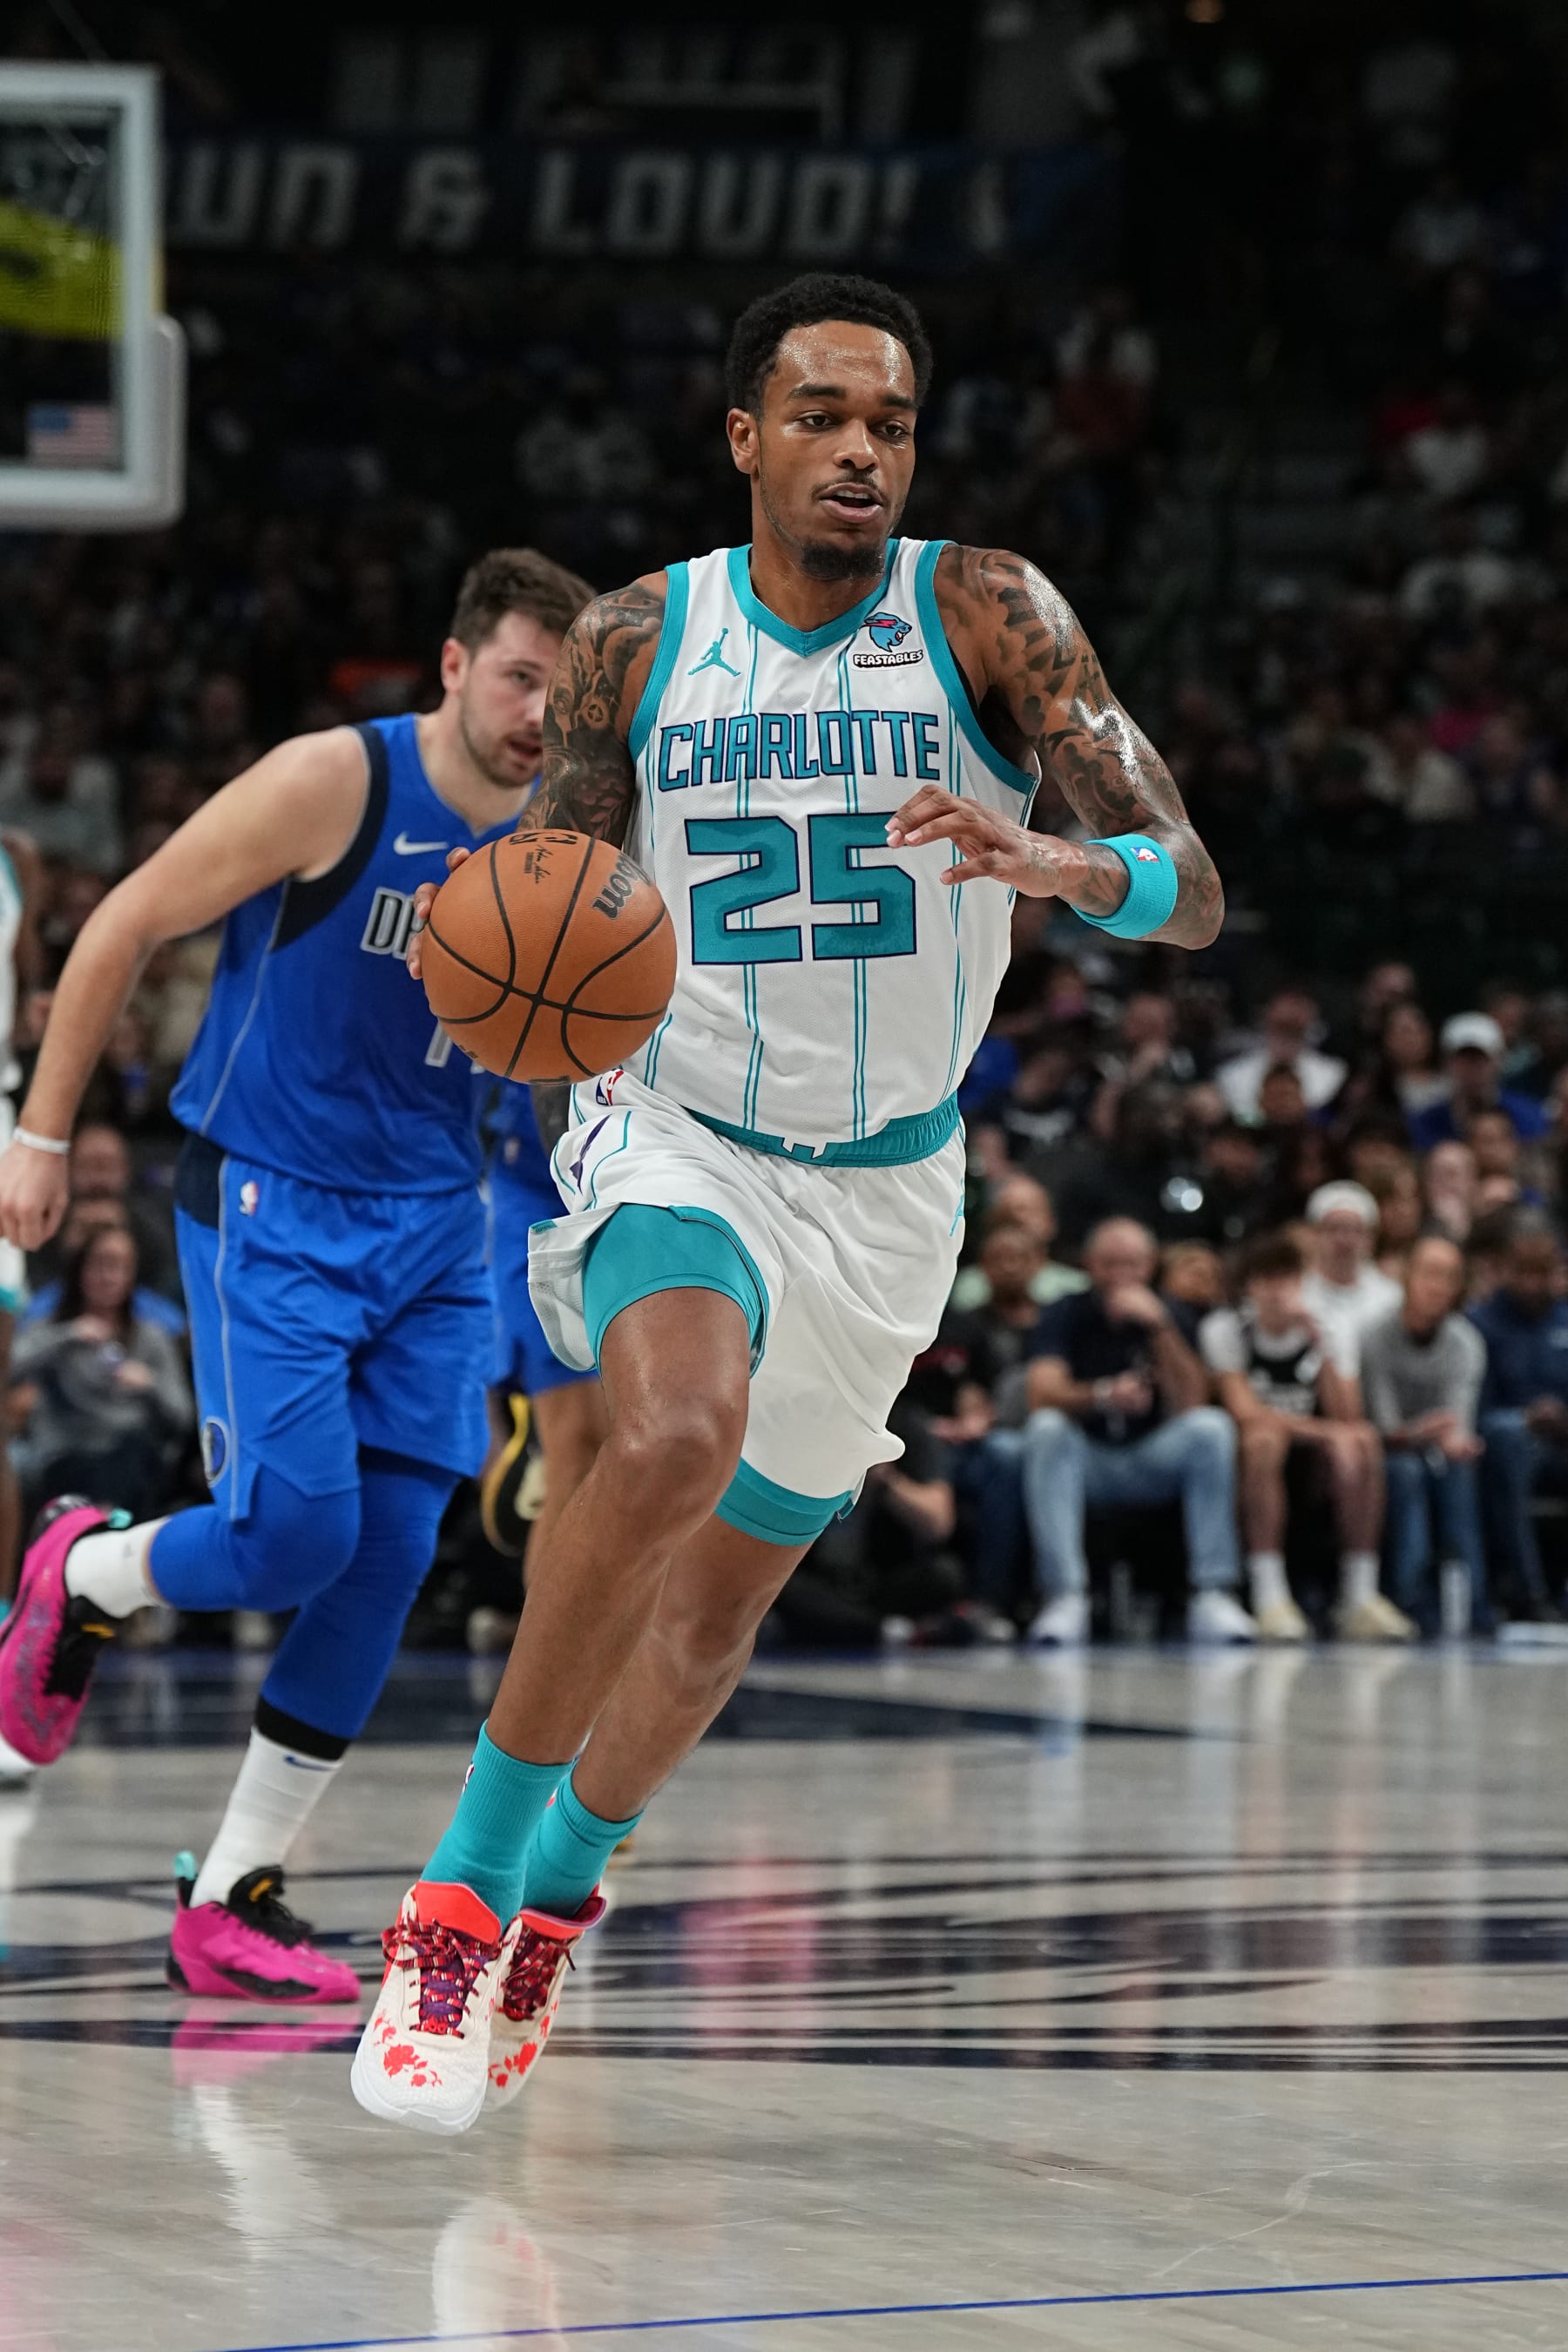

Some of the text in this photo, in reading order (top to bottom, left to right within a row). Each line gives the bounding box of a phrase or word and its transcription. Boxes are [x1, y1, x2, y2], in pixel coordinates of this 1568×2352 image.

[179, 142, 358, 253] UN
[531, 143, 919, 256] LOUD!
[853, 650, 924, 668] FEASTABLES
[658, 710, 941, 793] CHARLOTTE
[684, 811, 917, 965] 25
